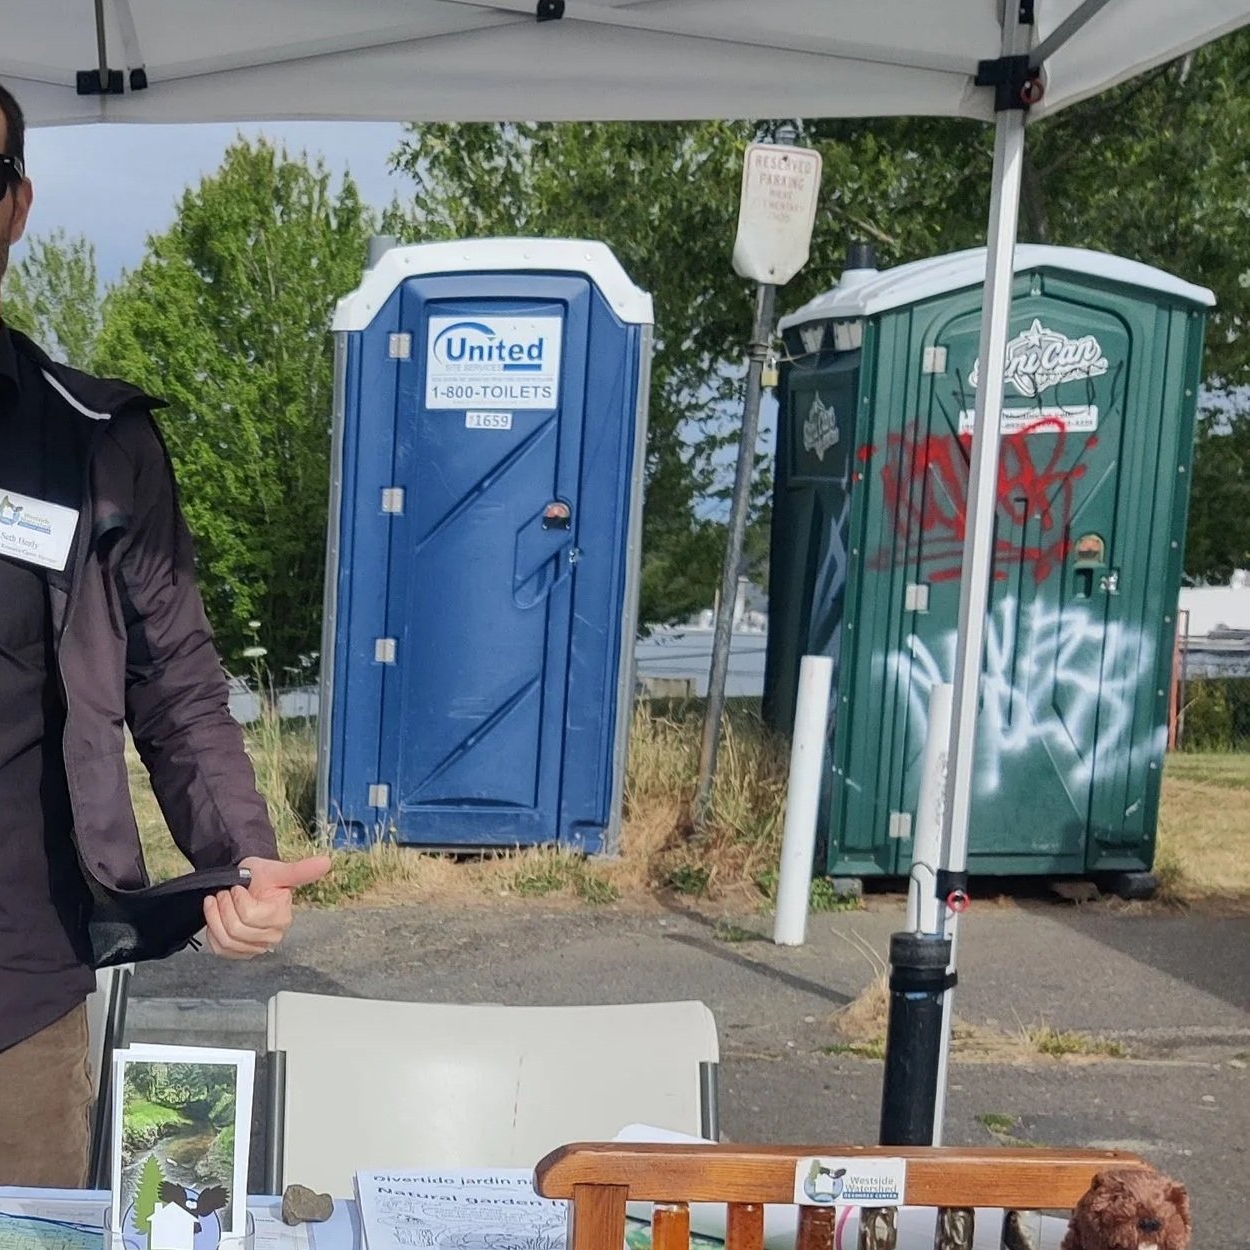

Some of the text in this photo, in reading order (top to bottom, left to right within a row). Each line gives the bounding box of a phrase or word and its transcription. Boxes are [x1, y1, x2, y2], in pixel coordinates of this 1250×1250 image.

[446, 337, 543, 362] United
[431, 385, 552, 399] 1-800-TOILETS
[374, 1176, 454, 1184] Divertido
[850, 1176, 894, 1184] Westside
[846, 1184, 897, 1192] Watershed
[378, 1187, 542, 1206] Natural garden
